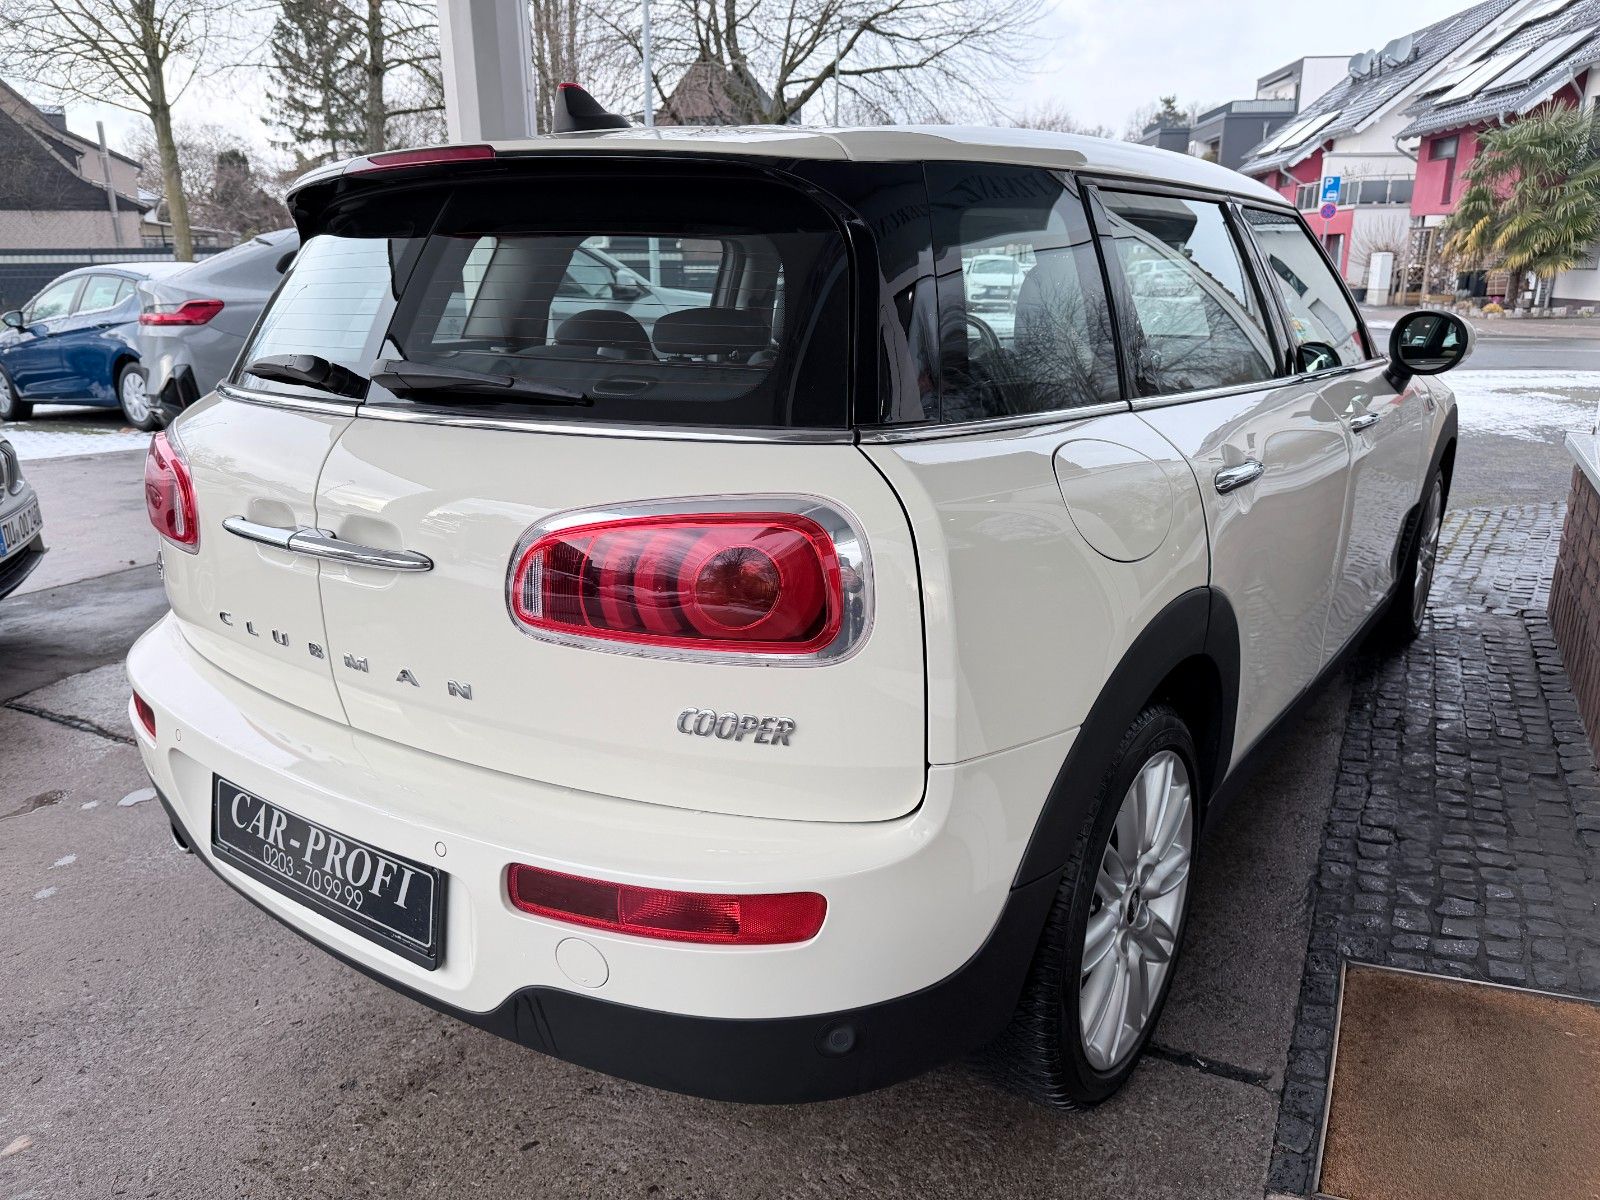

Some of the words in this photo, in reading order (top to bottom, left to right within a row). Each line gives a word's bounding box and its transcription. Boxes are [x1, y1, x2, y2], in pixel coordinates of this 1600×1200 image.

[1325, 177, 1335, 189] P
[219, 611, 473, 701] CLUBMAN
[677, 707, 796, 746] COOPER
[231, 792, 416, 909] CAR-PROFI
[263, 844, 294, 876] 0203
